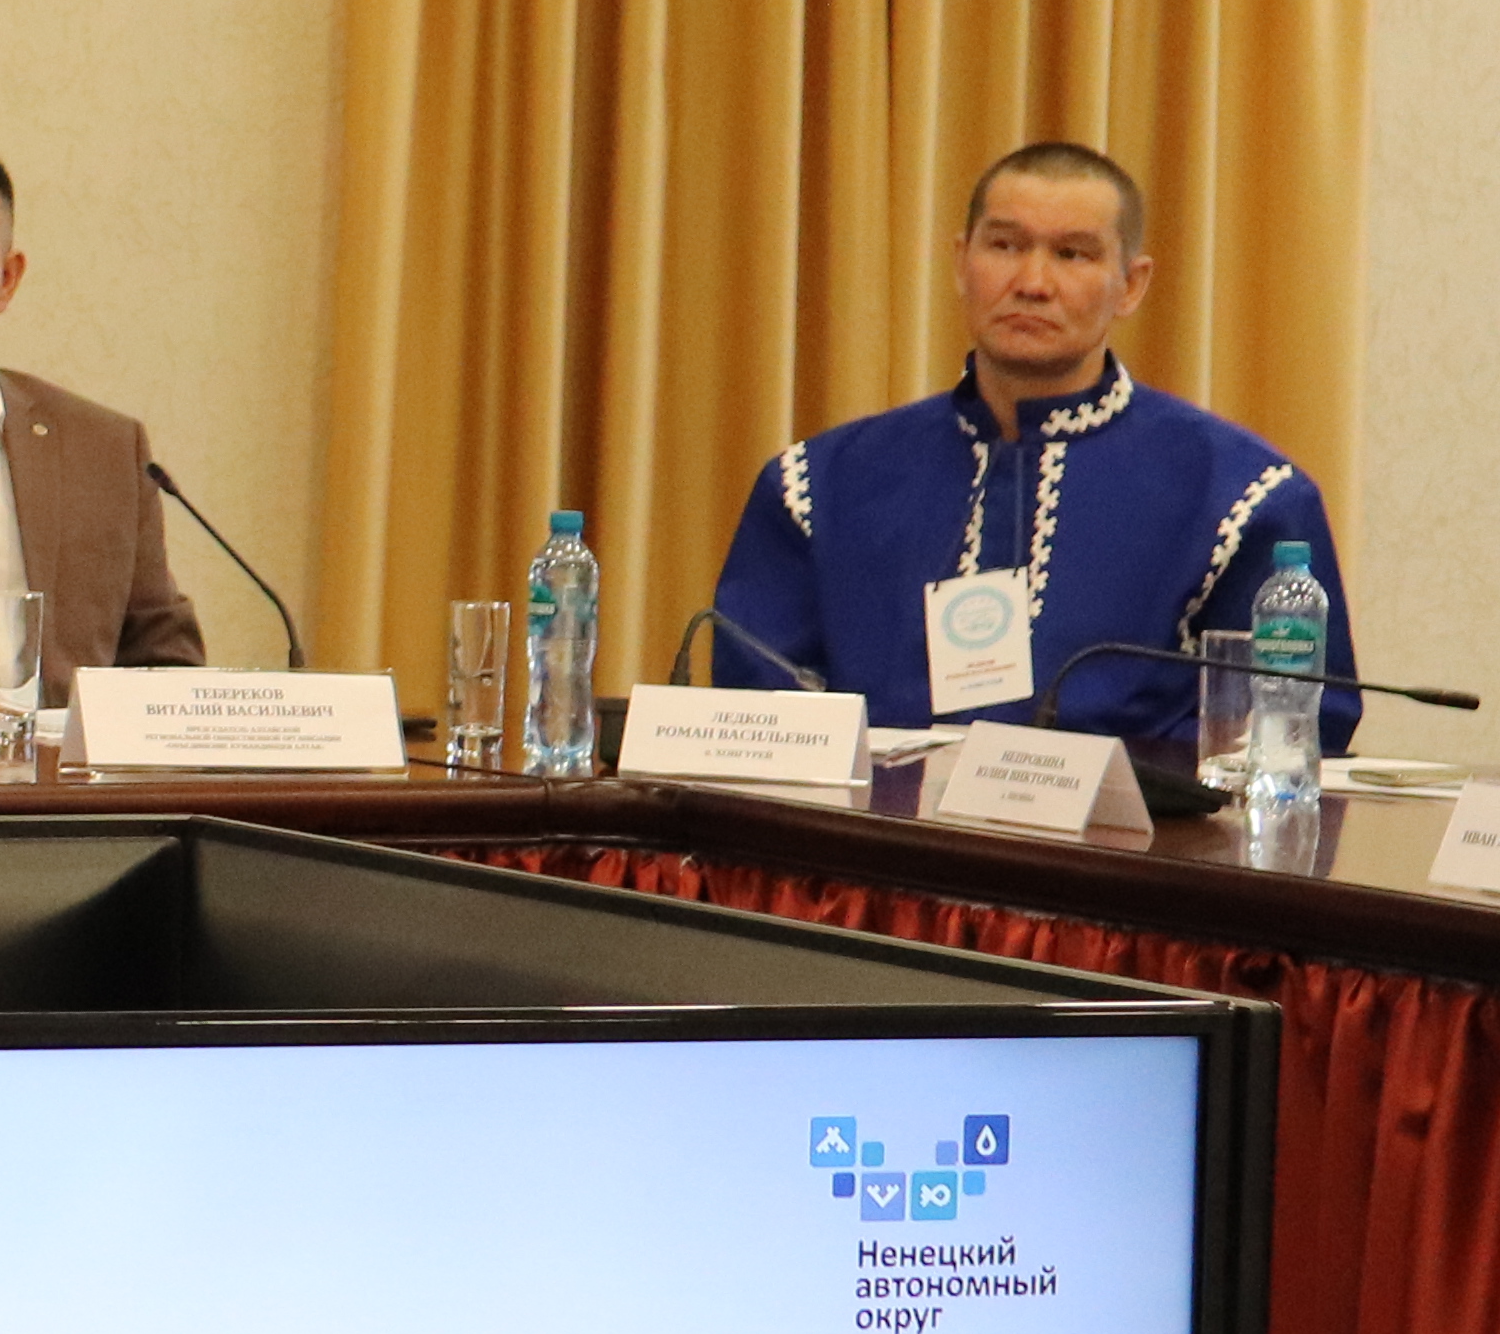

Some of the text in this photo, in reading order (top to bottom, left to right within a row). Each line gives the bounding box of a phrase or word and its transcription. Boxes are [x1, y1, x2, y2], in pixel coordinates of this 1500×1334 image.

[191, 687, 284, 701] ТЕБЕРЕКОВ
[146, 703, 334, 718] ВИТАЛИЙ ВАСИЛЬЕВИЧ
[711, 711, 779, 726] ЛЕДКОВ
[654, 724, 830, 747] РОМАН ВАСИЛЬЕВИЧ
[858, 1235, 1016, 1272] Ненецкий
[855, 1265, 1057, 1299] автономный
